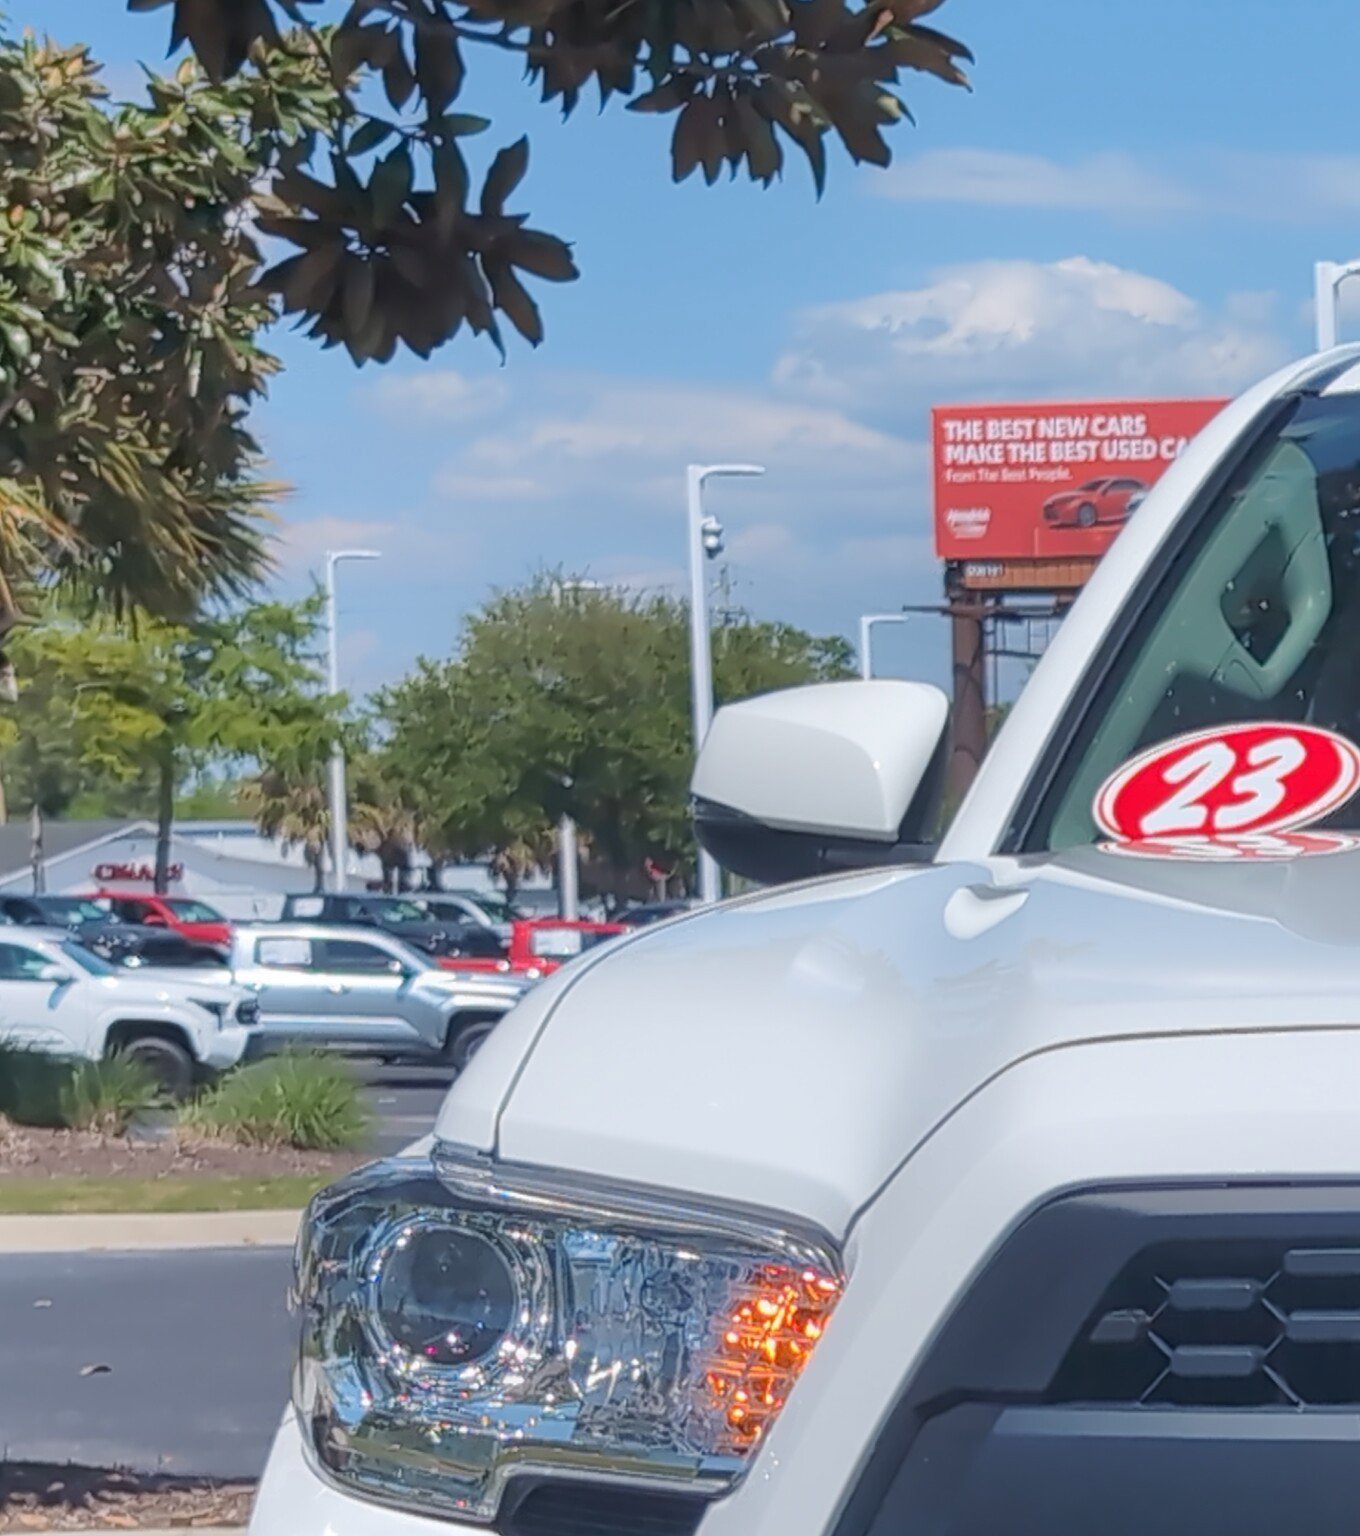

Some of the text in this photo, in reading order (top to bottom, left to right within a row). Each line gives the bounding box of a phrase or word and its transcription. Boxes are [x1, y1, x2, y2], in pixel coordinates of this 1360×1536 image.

[943, 413, 1146, 442] THE BEST NEW CARS
[943, 442, 1004, 466] MAKE
[1006, 441, 1047, 465] THE
[1048, 440, 1099, 463] BEST
[1101, 438, 1158, 461] USED
[1139, 736, 1307, 835] 23
